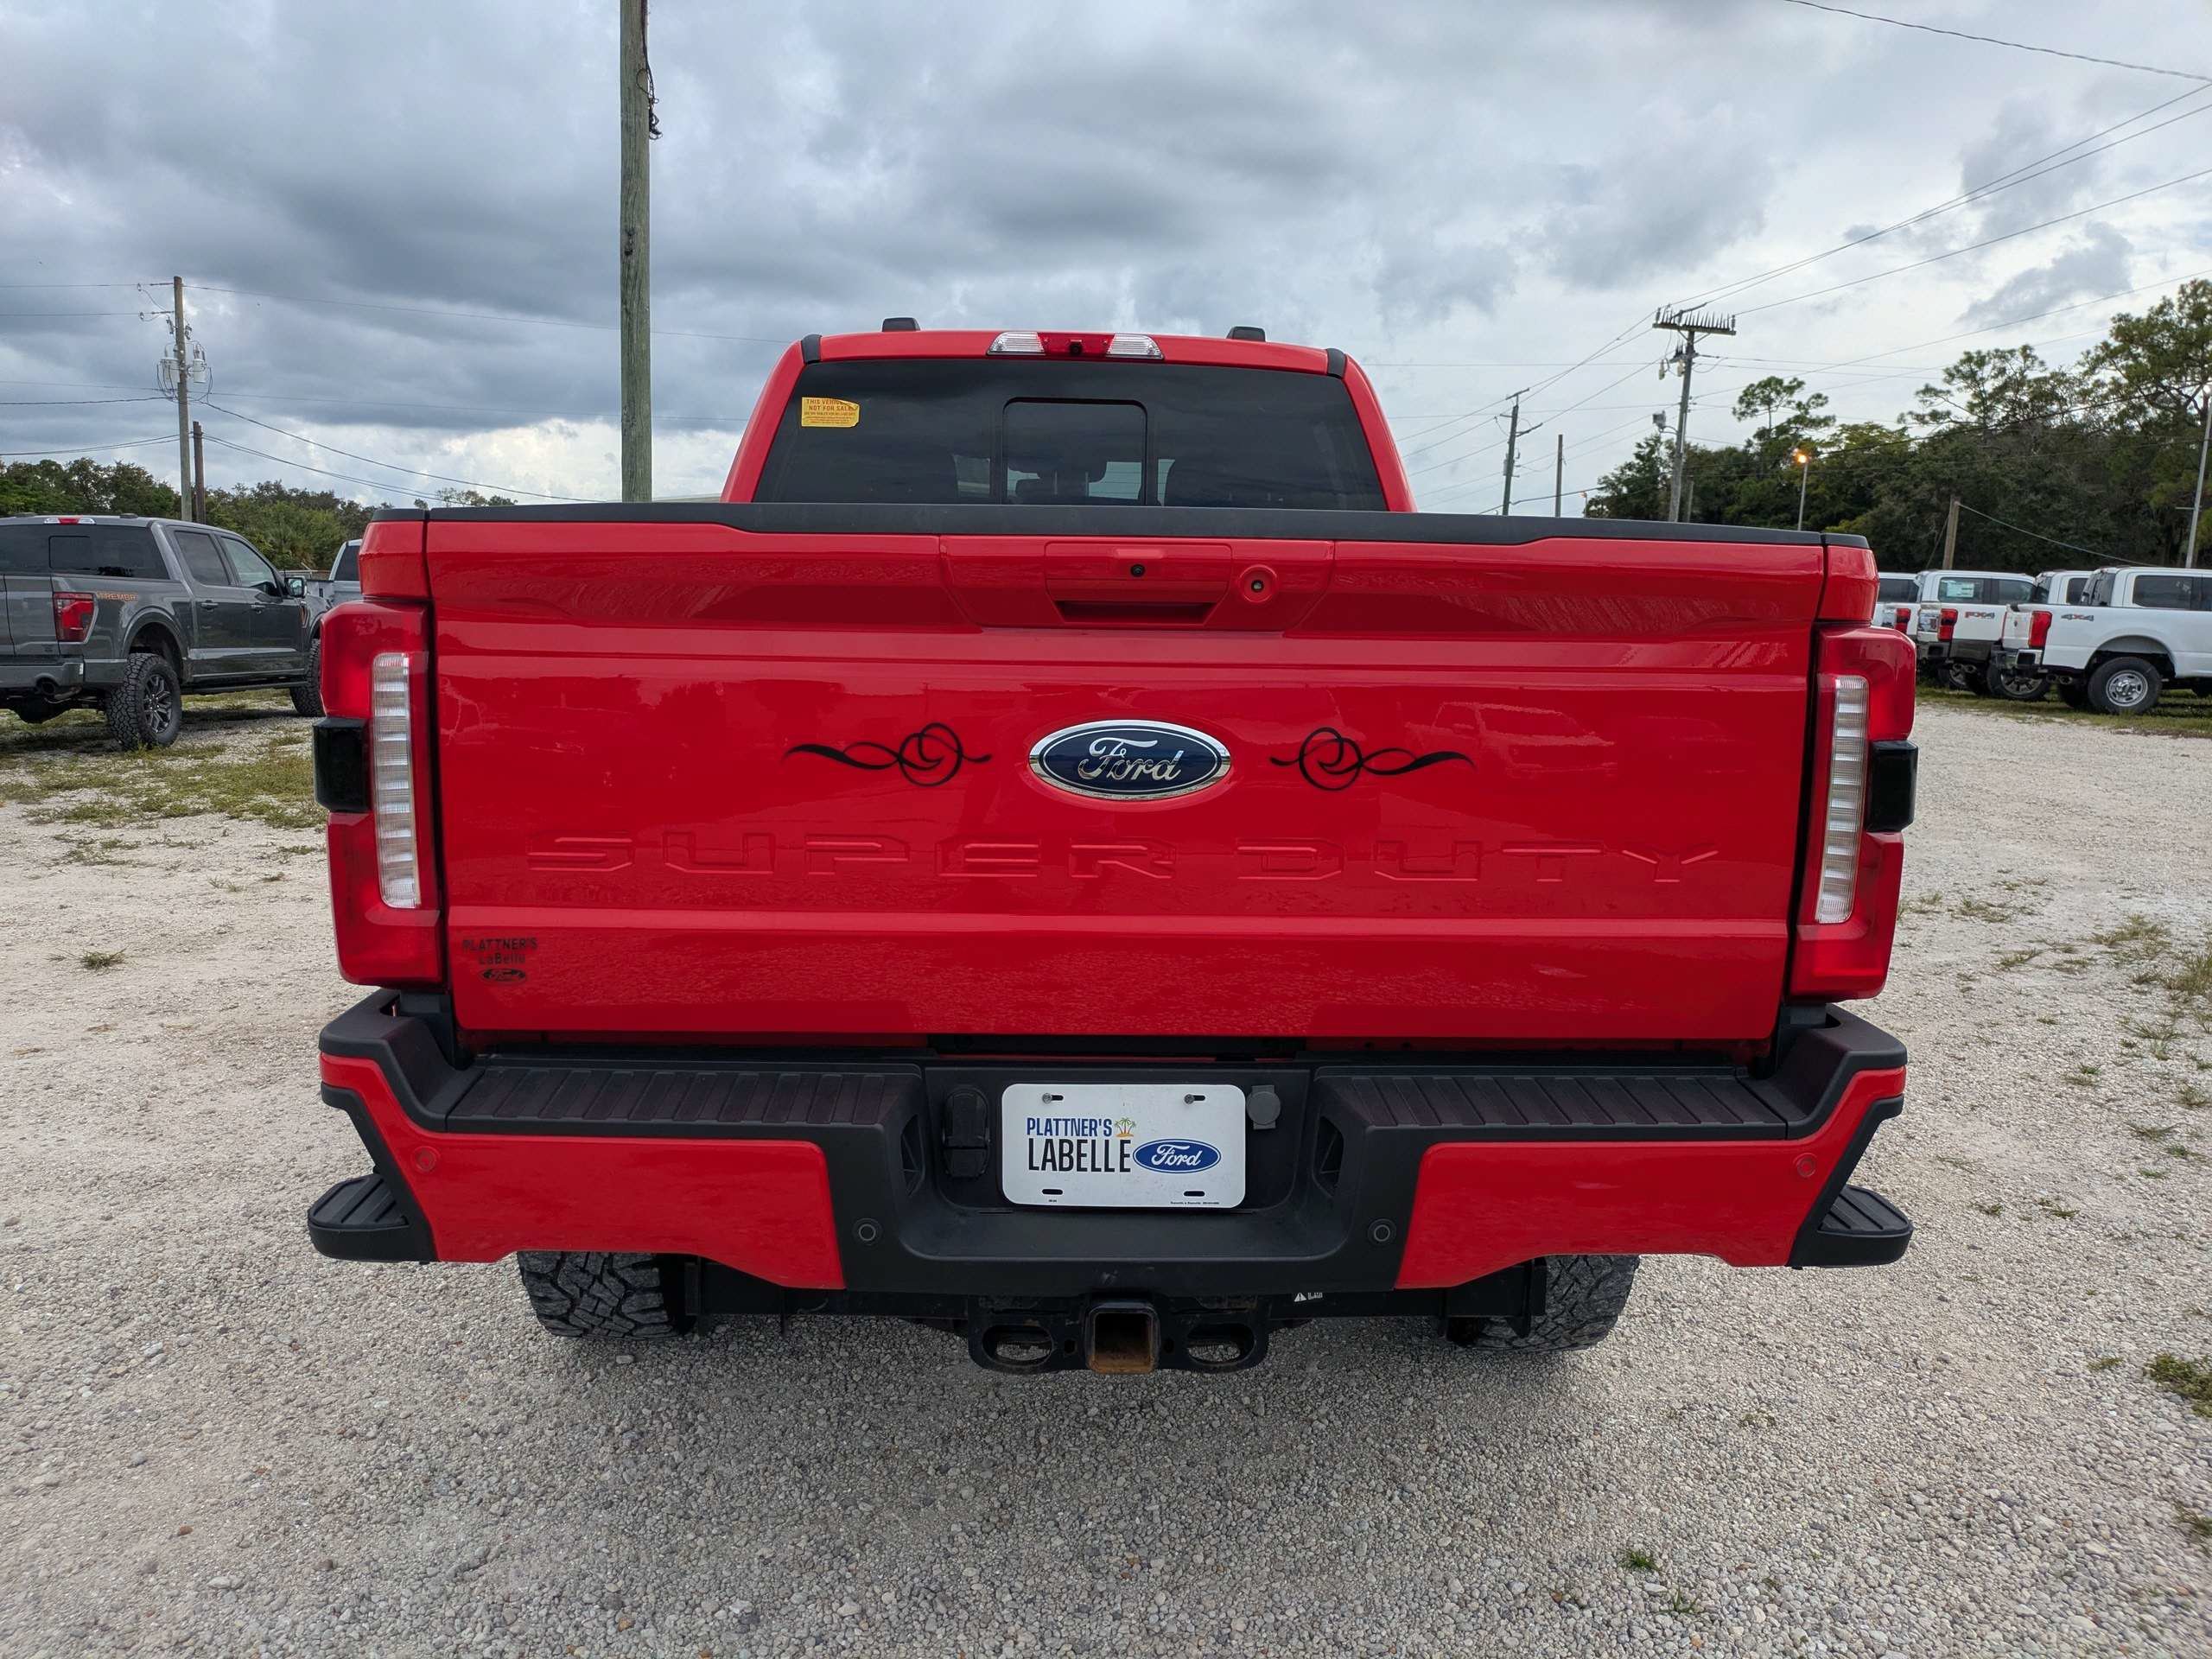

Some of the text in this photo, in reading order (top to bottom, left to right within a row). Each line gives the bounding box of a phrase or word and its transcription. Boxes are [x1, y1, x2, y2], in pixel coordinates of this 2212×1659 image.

[1964, 611, 1995, 620] FX4
[1077, 737, 1185, 781] Ford
[525, 830, 1719, 883] SUPER DUTY
[462, 937, 538, 952] PLATTNER'S
[1027, 1117, 1113, 1137] PLATTNER'S
[1027, 1138, 1204, 1173] LABELLE Ford
